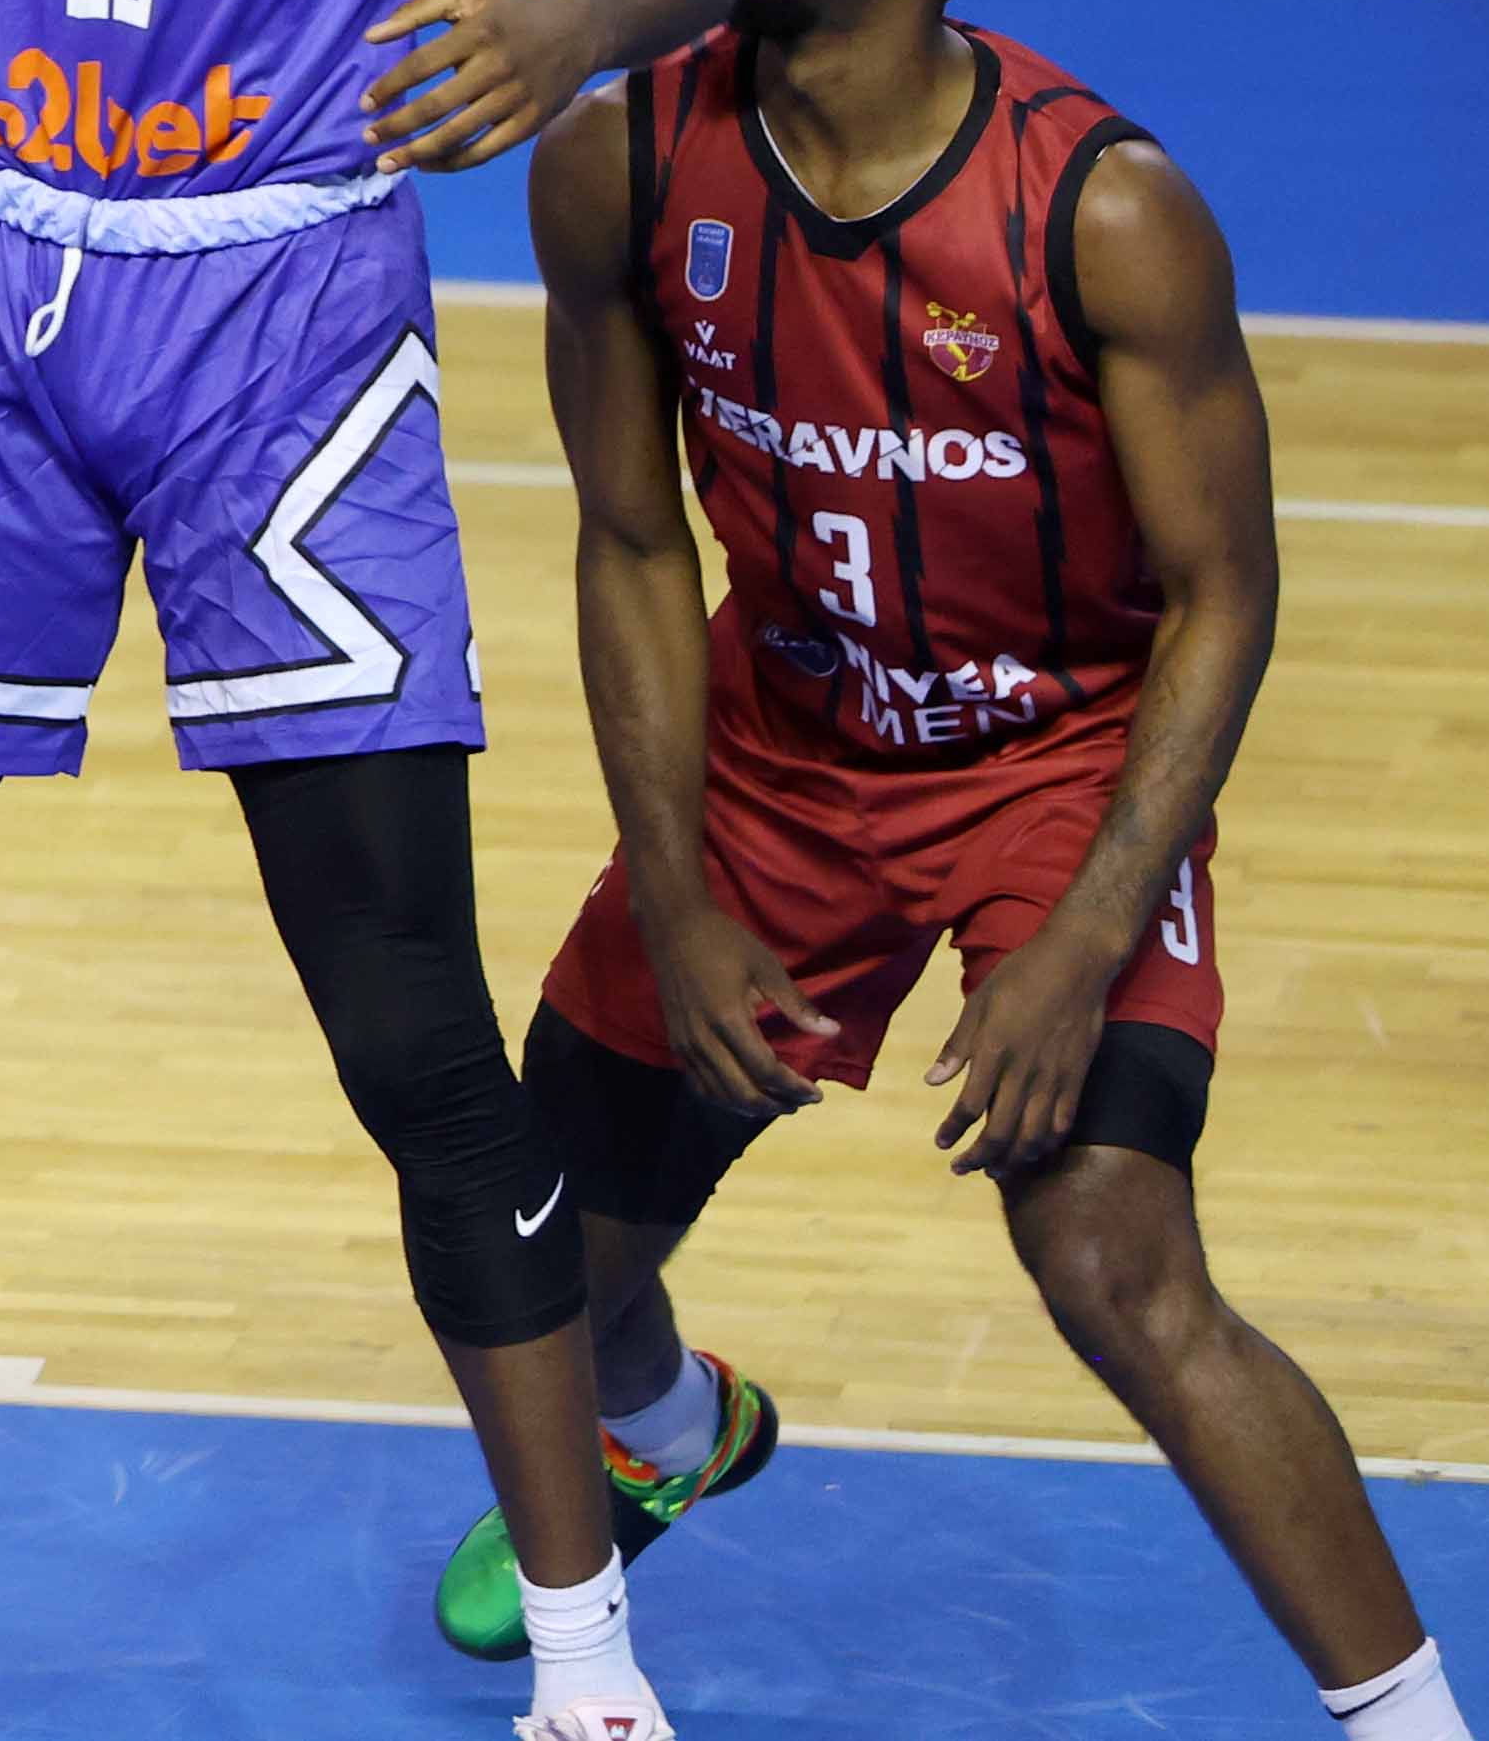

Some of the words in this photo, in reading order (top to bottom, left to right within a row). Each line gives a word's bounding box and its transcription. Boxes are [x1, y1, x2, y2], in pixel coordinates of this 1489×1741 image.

[812, 511, 876, 627] 3
[837, 632, 1037, 703] NIVEA
[861, 680, 1036, 745] MEN
